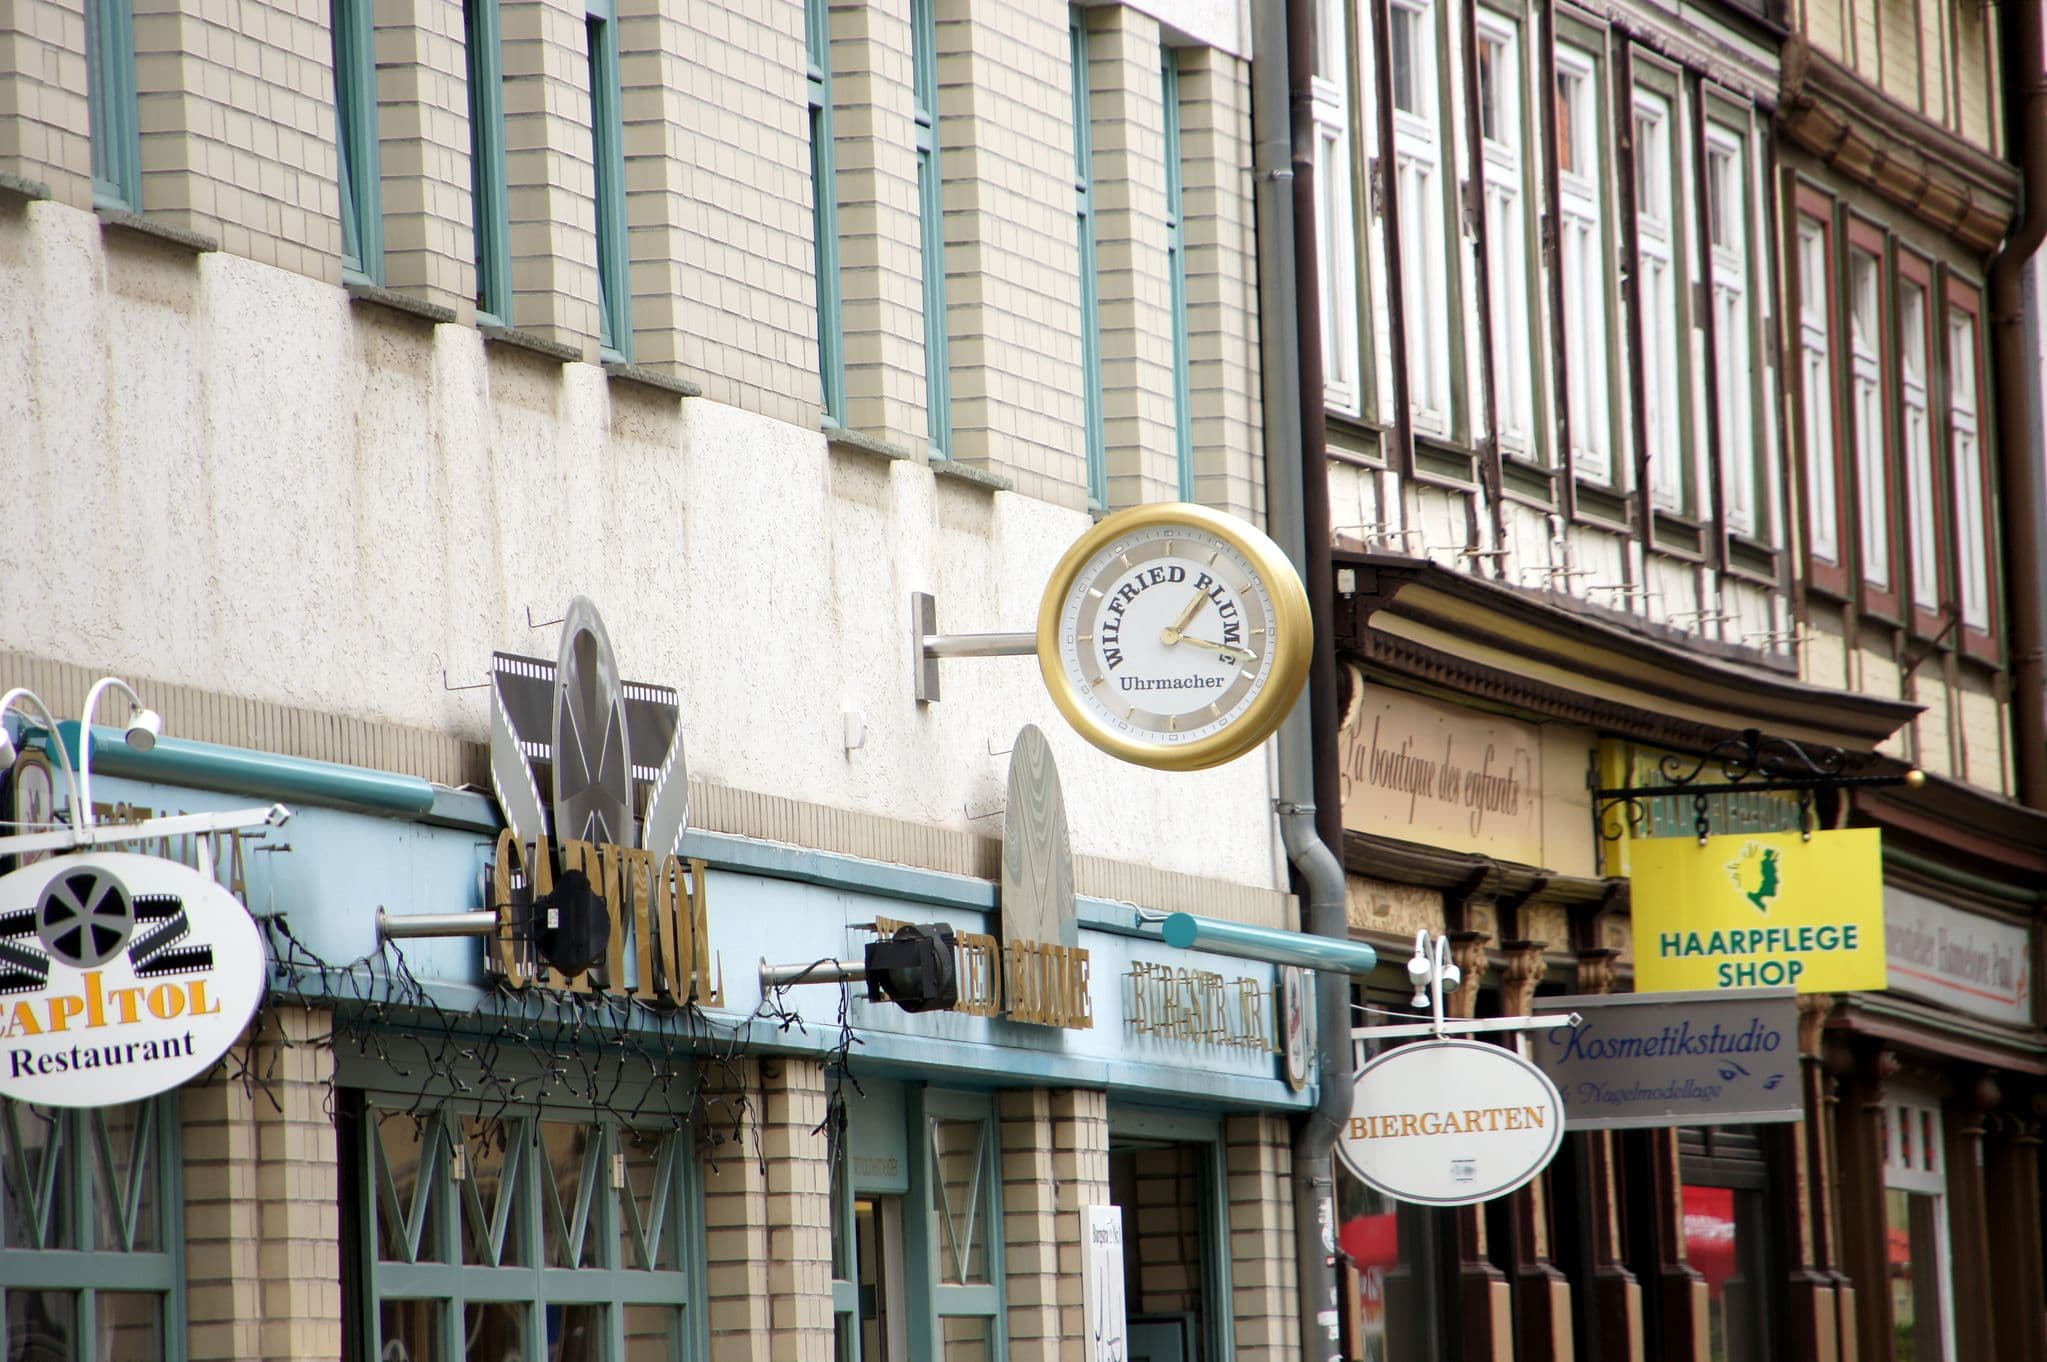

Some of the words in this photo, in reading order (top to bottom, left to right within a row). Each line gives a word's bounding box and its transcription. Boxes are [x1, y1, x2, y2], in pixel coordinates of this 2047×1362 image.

[1102, 565, 1186, 670] WILFRIED
[1120, 674, 1225, 691] Uhrmacher
[1370, 715, 1436, 825] boutique
[1439, 733, 1461, 805] des
[1465, 744, 1521, 838] enfants
[1660, 925, 1858, 957] HAARPFLEGE
[1718, 960, 1804, 987] SHOP
[0, 971, 220, 1038] APITOL
[9, 1030, 196, 1079] Restaurant
[1549, 1017, 1781, 1064] Kosmetikstudio
[1578, 1079, 1722, 1105] Nagelmodellage
[1349, 1105, 1545, 1140] BIERGARTEN
